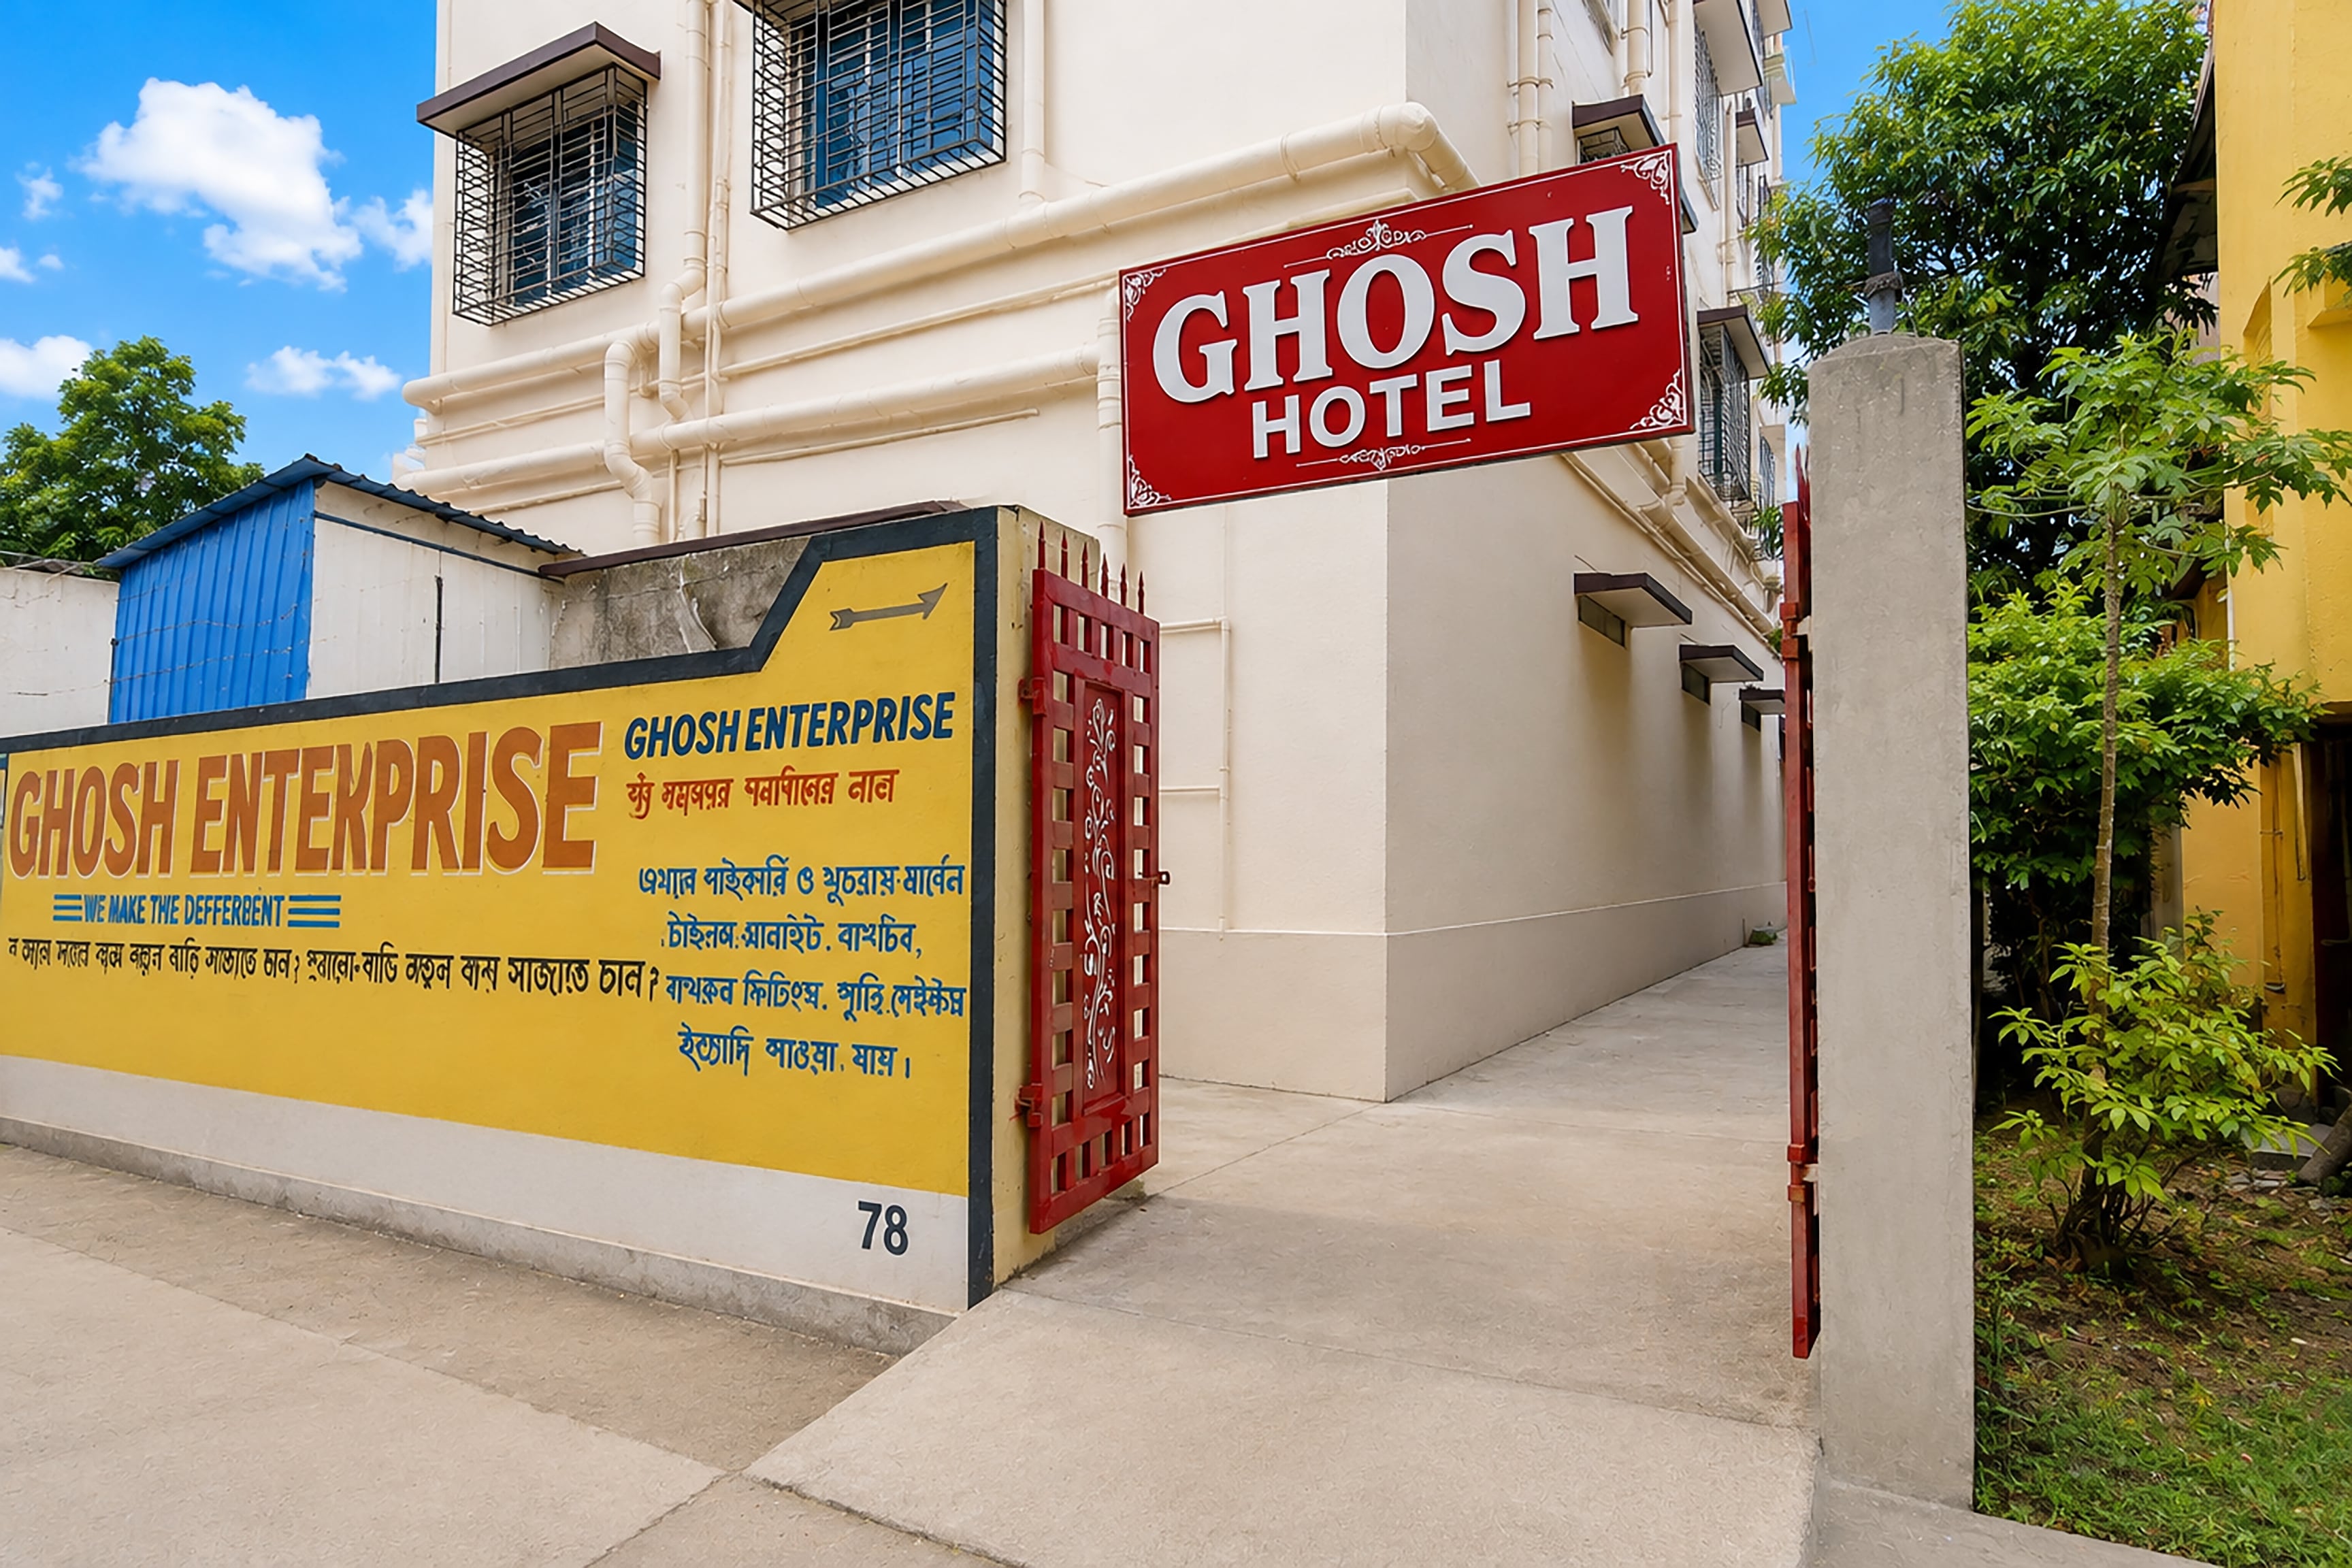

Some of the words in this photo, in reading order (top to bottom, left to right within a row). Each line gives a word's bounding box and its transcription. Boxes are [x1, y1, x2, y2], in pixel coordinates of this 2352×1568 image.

[1153, 206, 1638, 403] GHOSH
[1251, 359, 1531, 459] HOTEL
[624, 710, 741, 760] GHOSH
[745, 691, 956, 751] ENTERPRISE
[9, 759, 181, 879] GHOSH
[84, 895, 106, 922] WE
[108, 895, 146, 924] MAKE
[150, 895, 180, 924] THE
[858, 1200, 909, 1256] 78
